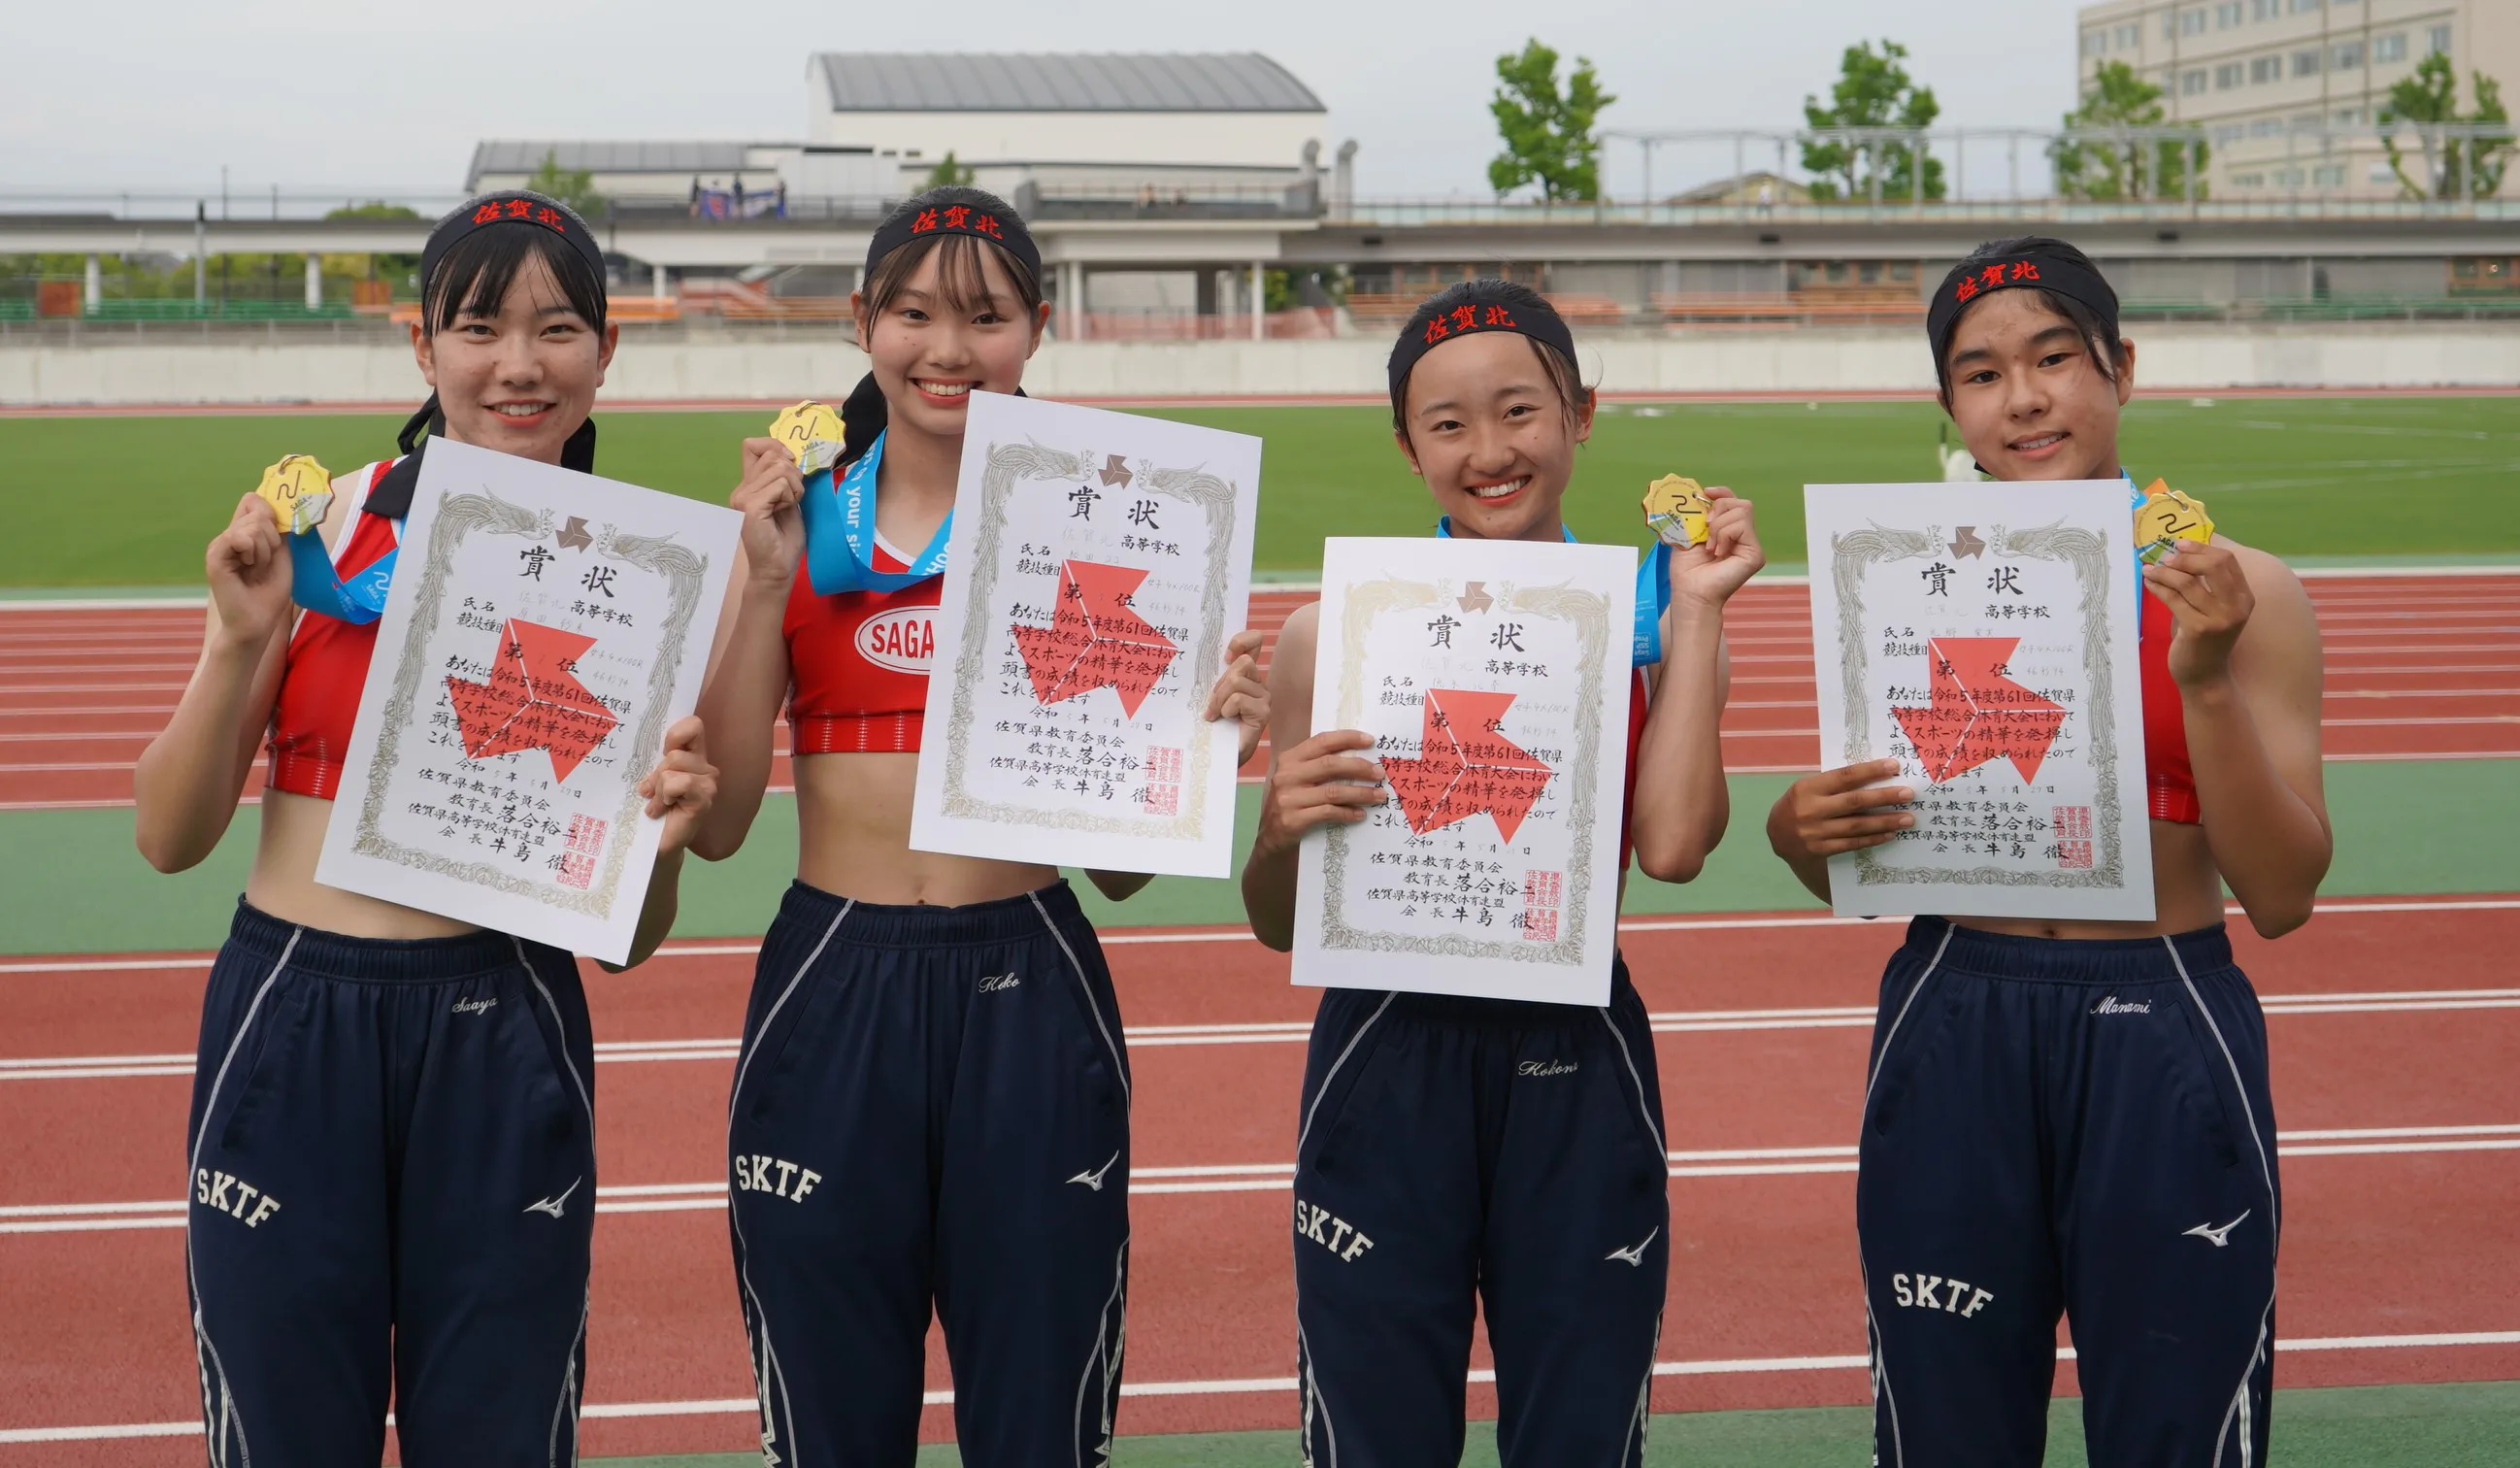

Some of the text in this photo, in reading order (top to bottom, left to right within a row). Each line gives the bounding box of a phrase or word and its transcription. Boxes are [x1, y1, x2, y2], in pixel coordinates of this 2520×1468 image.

[472, 199, 566, 232] 佐賀北
[911, 205, 1004, 240] 佐賀北
[1956, 260, 2040, 302] 佐賀北
[1424, 304, 1516, 344] 佐賀北
[846, 485, 862, 529] your
[1020, 543, 1051, 556] 氏名
[1121, 534, 1180, 556] 高等学校
[1015, 558, 1061, 577] 競技種目
[463, 596, 495, 613] 氏名
[571, 599, 633, 627] 高等学校
[1985, 604, 2051, 619] 高等学校
[456, 612, 504, 634] 競技種目
[1884, 626, 1914, 639] 氏名
[871, 619, 935, 659] SAGA
[1882, 641, 1928, 657] 競技種目
[1485, 659, 1548, 678] 高等学校
[1383, 676, 1413, 687] 氏名
[1379, 690, 1424, 706] 競技種目
[995, 719, 1125, 748] 佐賀県教育委員会
[1890, 763, 1984, 781] れを賞します
[418, 768, 550, 812] 佐賀県教育委員会
[1891, 799, 2029, 814] 佐賀県教育委員会
[1370, 851, 1503, 874] 佐賀県教育委員会
[450, 995, 499, 1016] Saaya
[2090, 995, 2153, 1016] Manami
[735, 1154, 823, 1204] SKTF
[197, 1168, 282, 1228] SKTF
[1297, 1198, 1375, 1263] SKTF
[1893, 1272, 1995, 1319] SKTF
